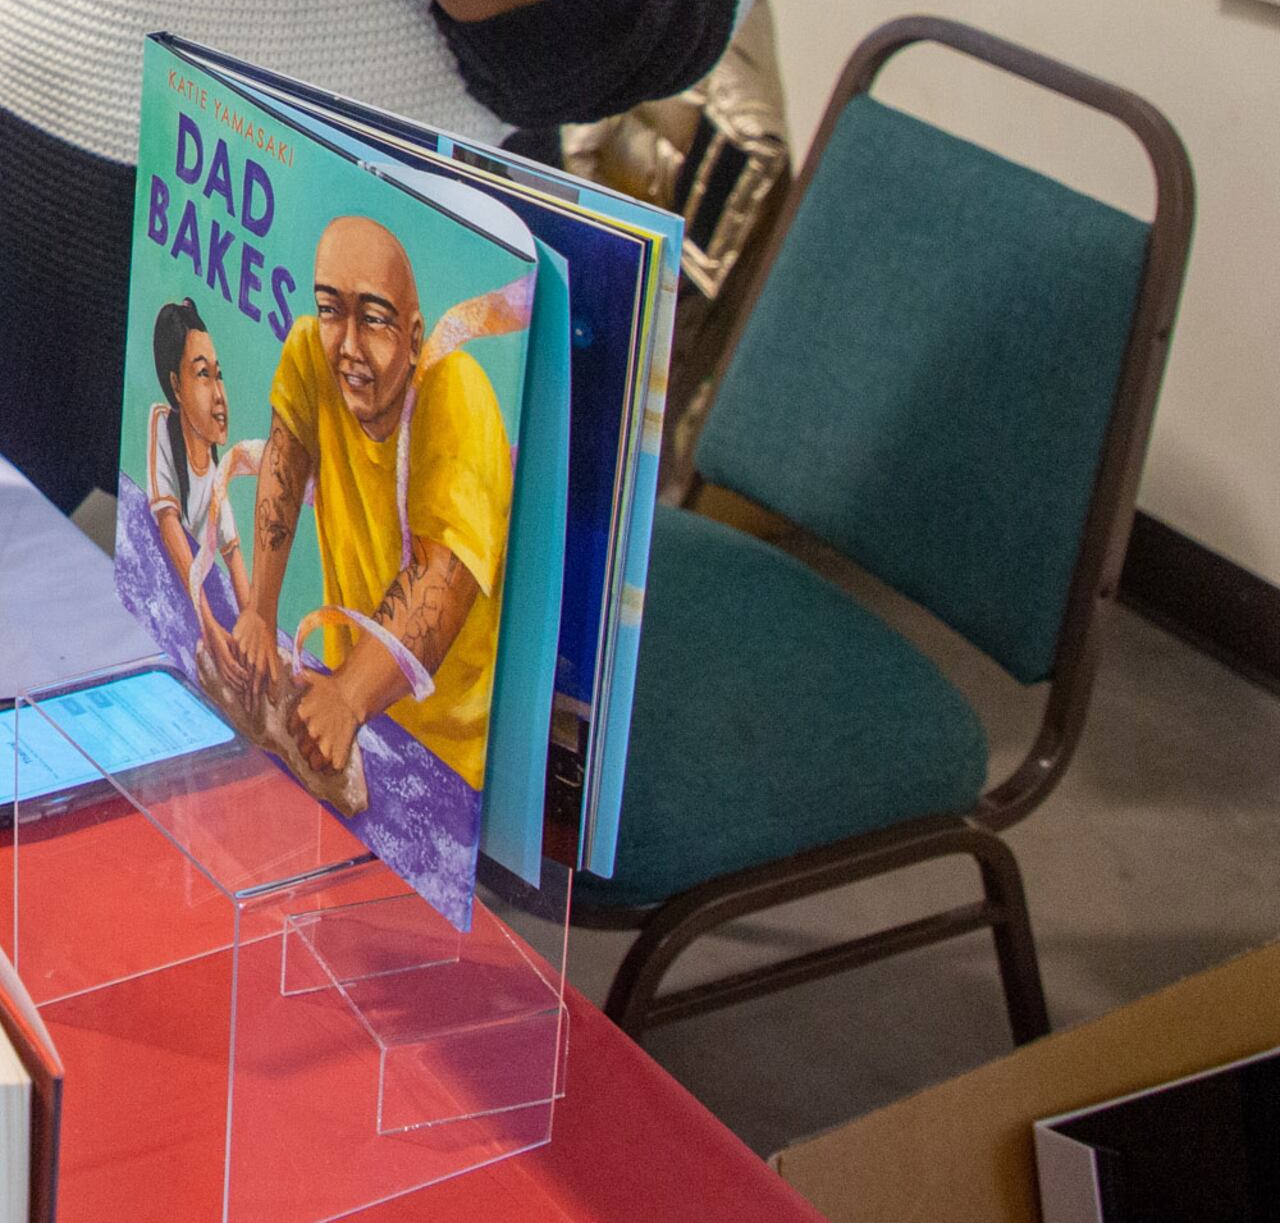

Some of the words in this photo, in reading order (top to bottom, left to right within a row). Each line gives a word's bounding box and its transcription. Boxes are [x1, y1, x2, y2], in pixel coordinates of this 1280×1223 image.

[168, 71, 209, 111] KATIE
[214, 98, 295, 169] YAMASAKI
[175, 112, 275, 238] DAD
[147, 174, 297, 344] BAKES
